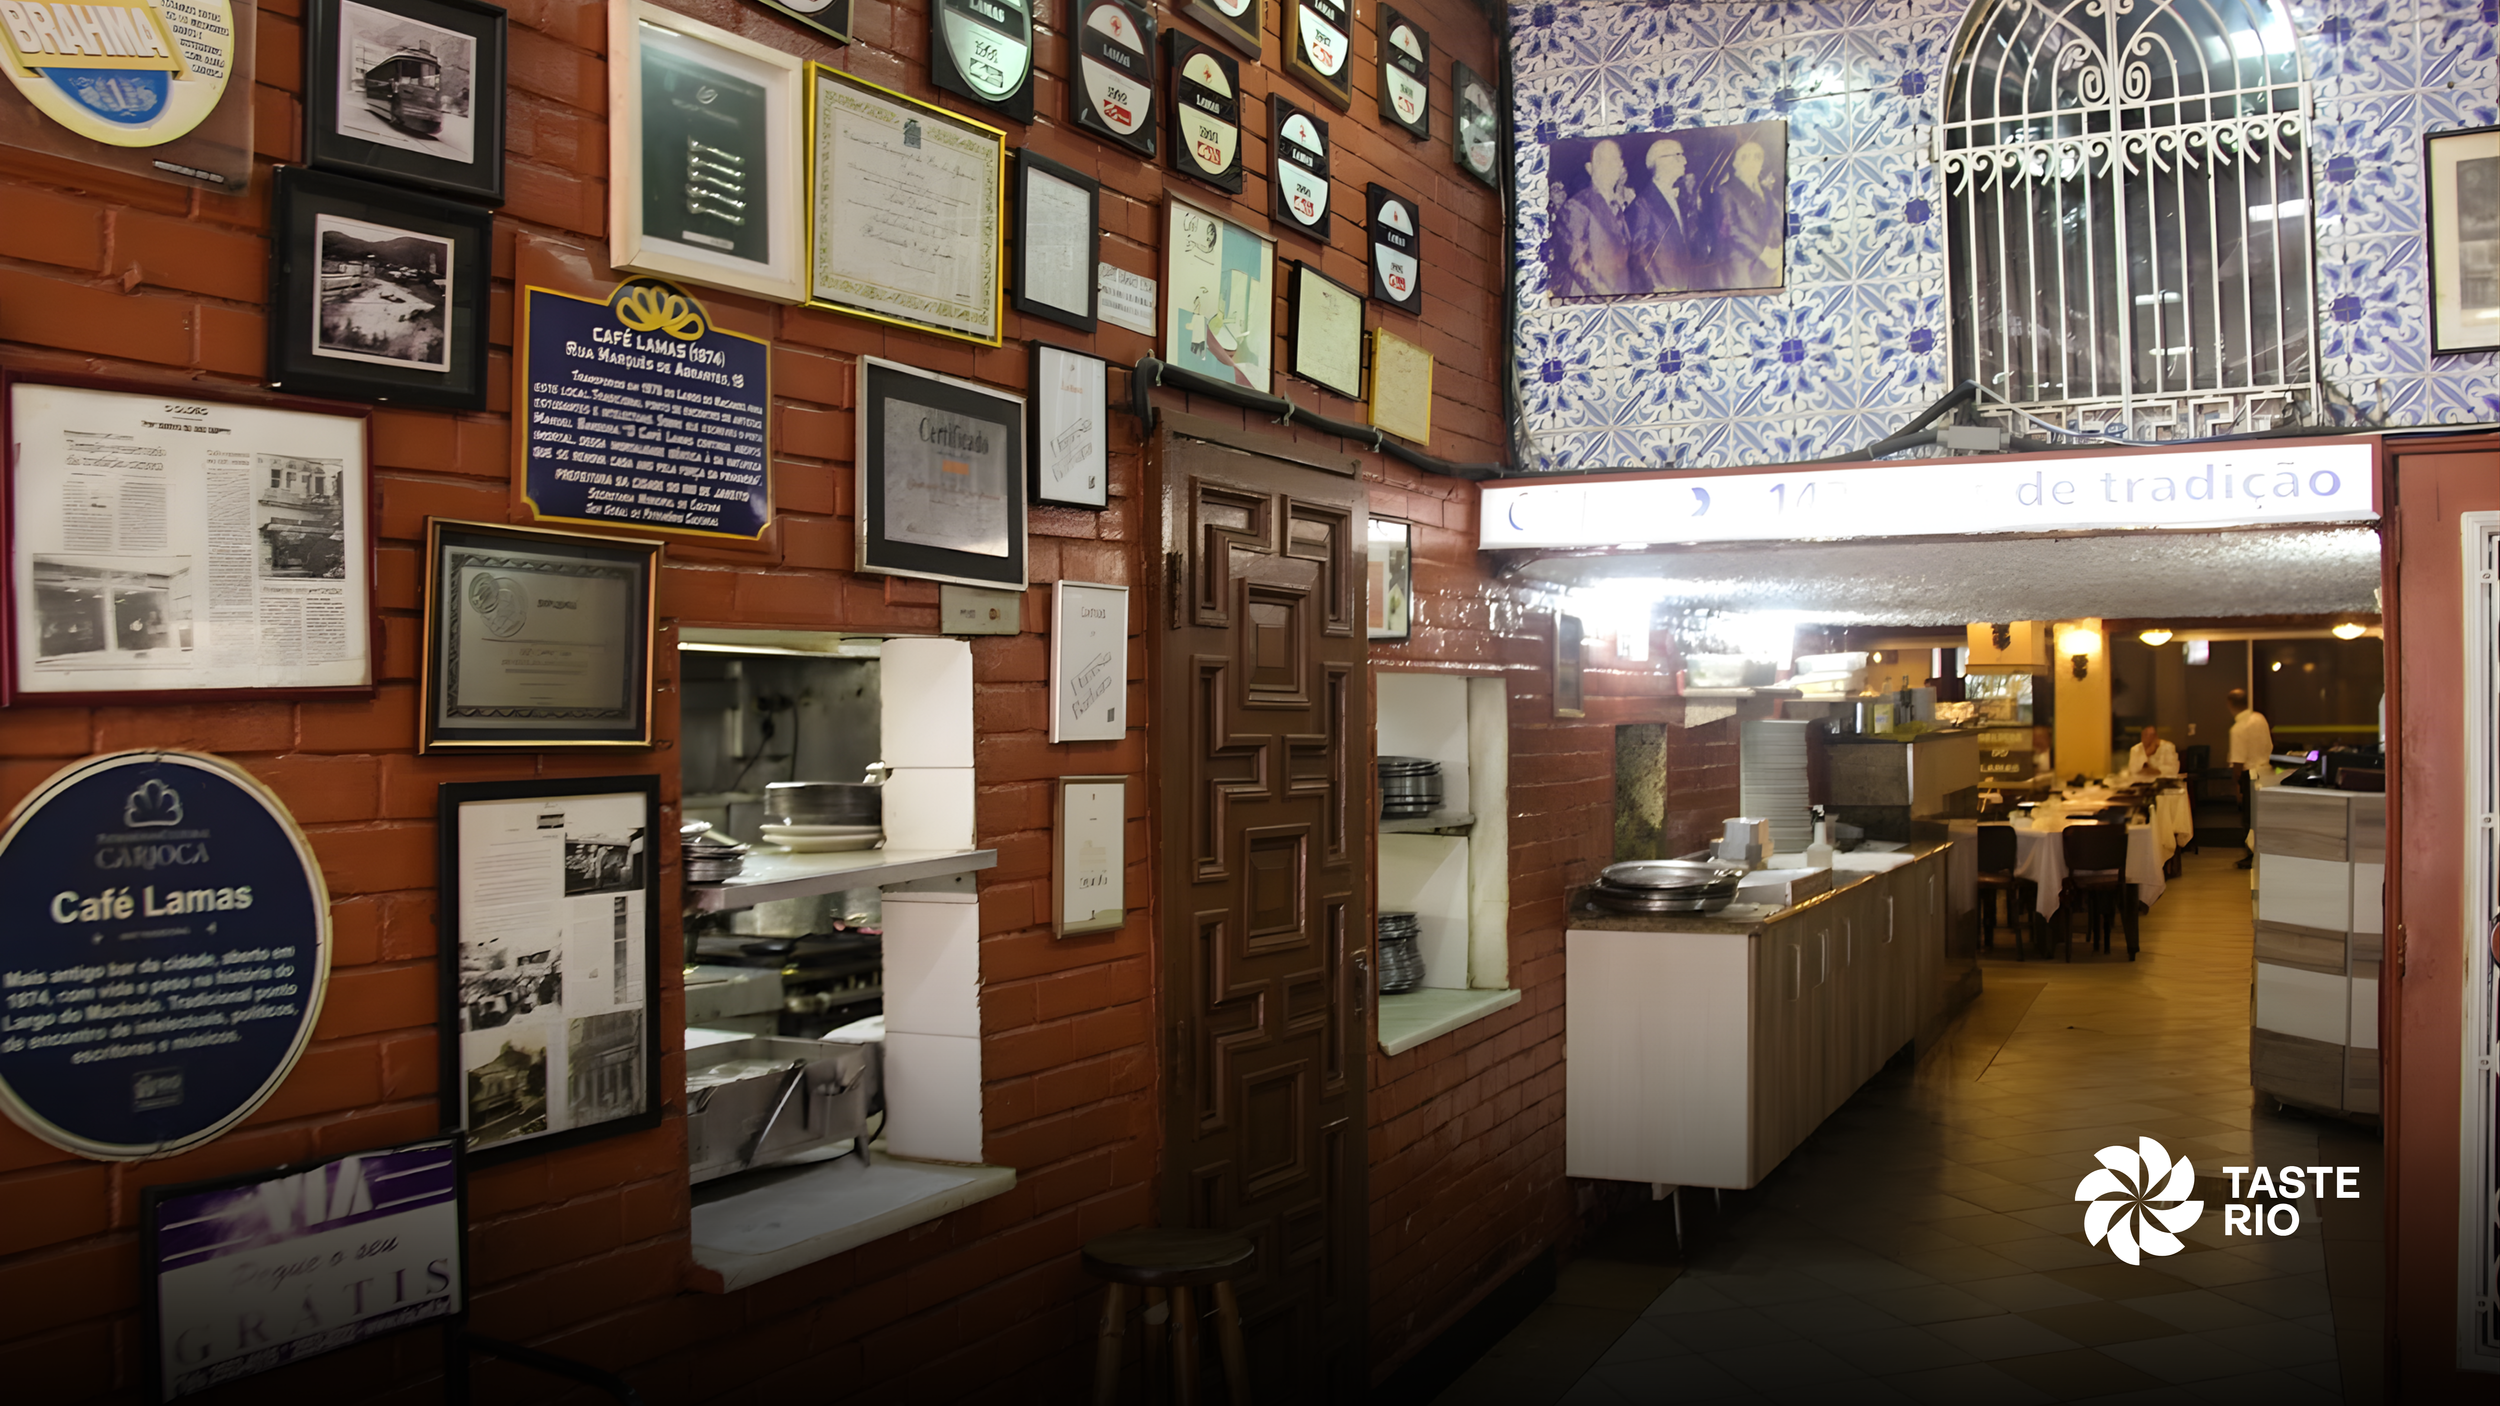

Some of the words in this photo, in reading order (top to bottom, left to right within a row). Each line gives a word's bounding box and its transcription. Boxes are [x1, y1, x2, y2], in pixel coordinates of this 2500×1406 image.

[0, 0, 169, 58] BRAHMA
[593, 327, 633, 347] CAFÉ
[636, 335, 686, 358] LAMAS
[689, 342, 725, 368] (1874)
[919, 417, 989, 455] Certificado
[2015, 470, 2076, 507] de
[2100, 461, 2342, 510] tradição
[50, 886, 135, 924] Café
[142, 885, 253, 918] Lamas
[329, 1251, 347, 1268] o
[355, 1236, 401, 1261] seu
[173, 1258, 451, 1368] GRÁTIS
